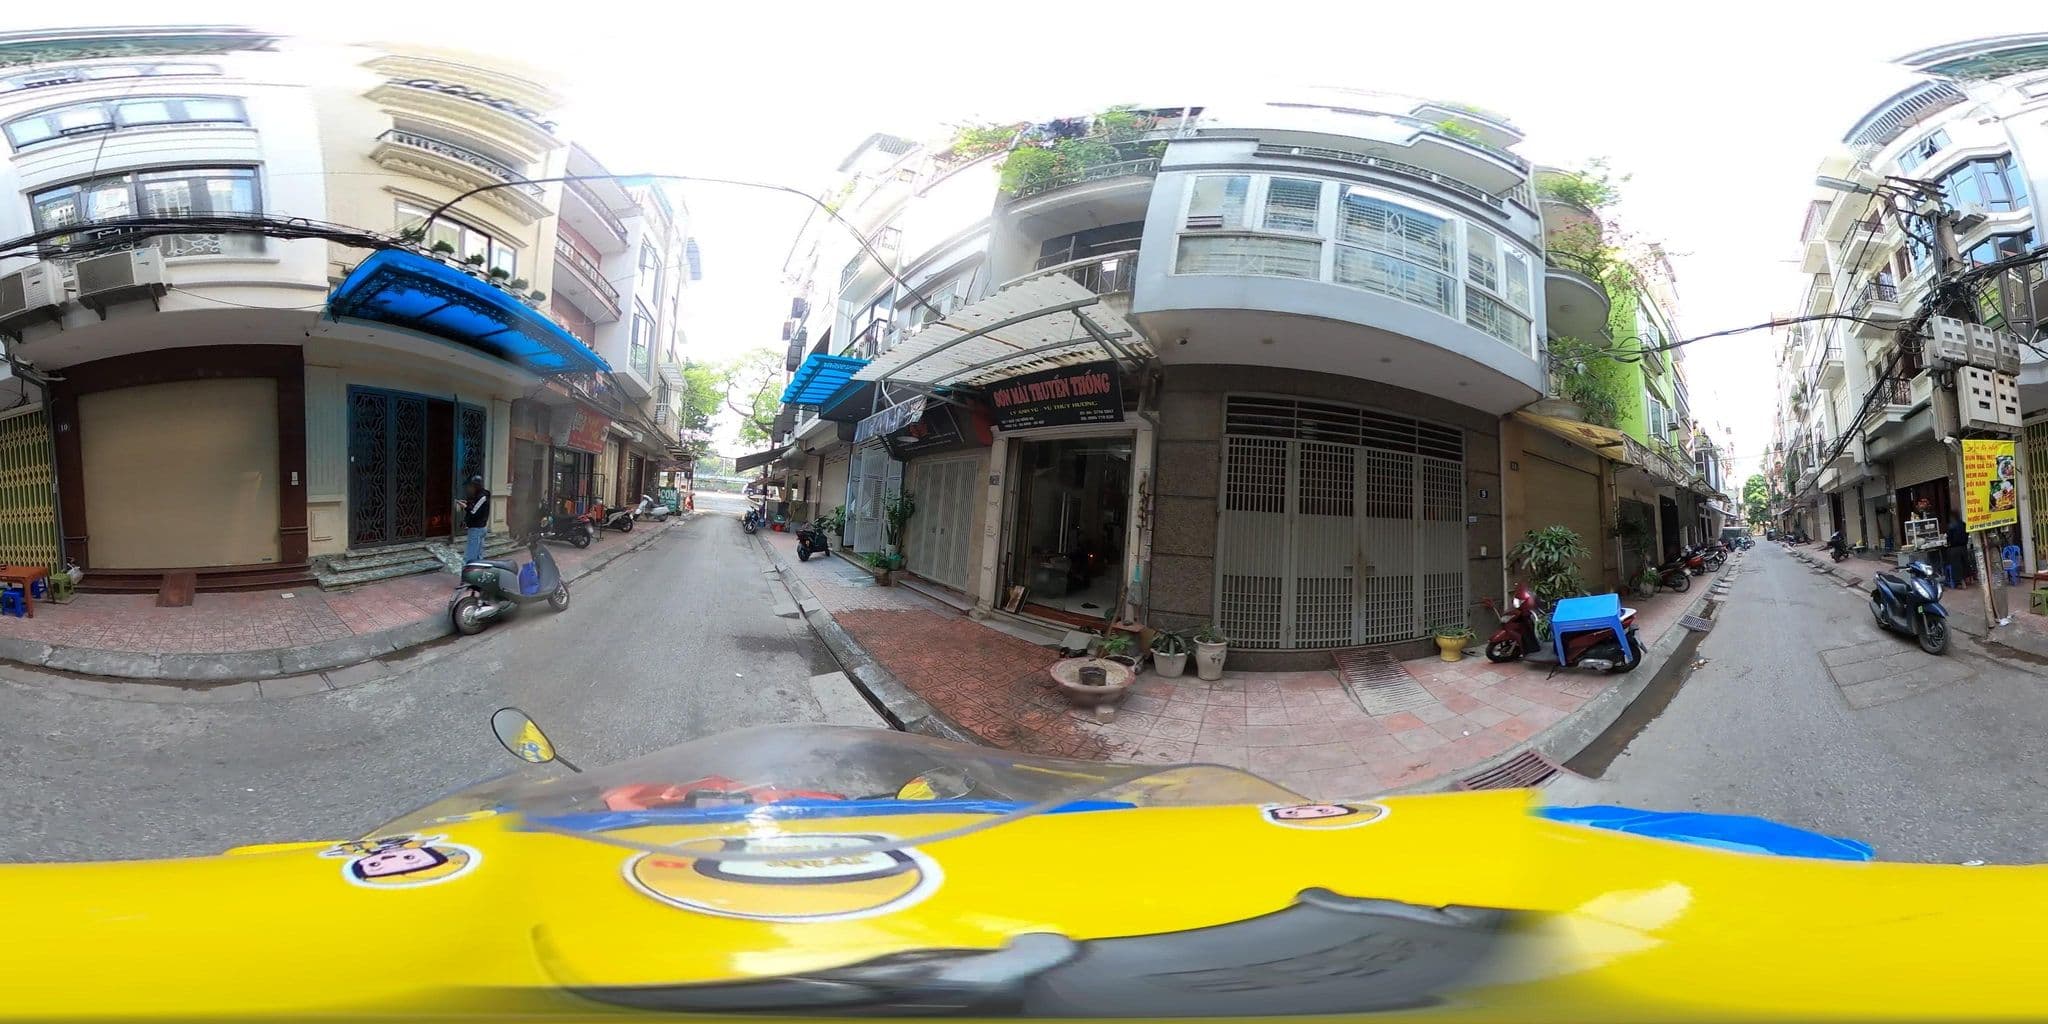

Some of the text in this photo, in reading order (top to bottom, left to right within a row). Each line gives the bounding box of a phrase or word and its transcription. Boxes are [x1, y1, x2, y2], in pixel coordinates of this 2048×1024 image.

[1010, 382, 1029, 404] MÀI
[1028, 374, 1071, 402] TRUYỀN
[1069, 369, 1111, 396] THỐNG
